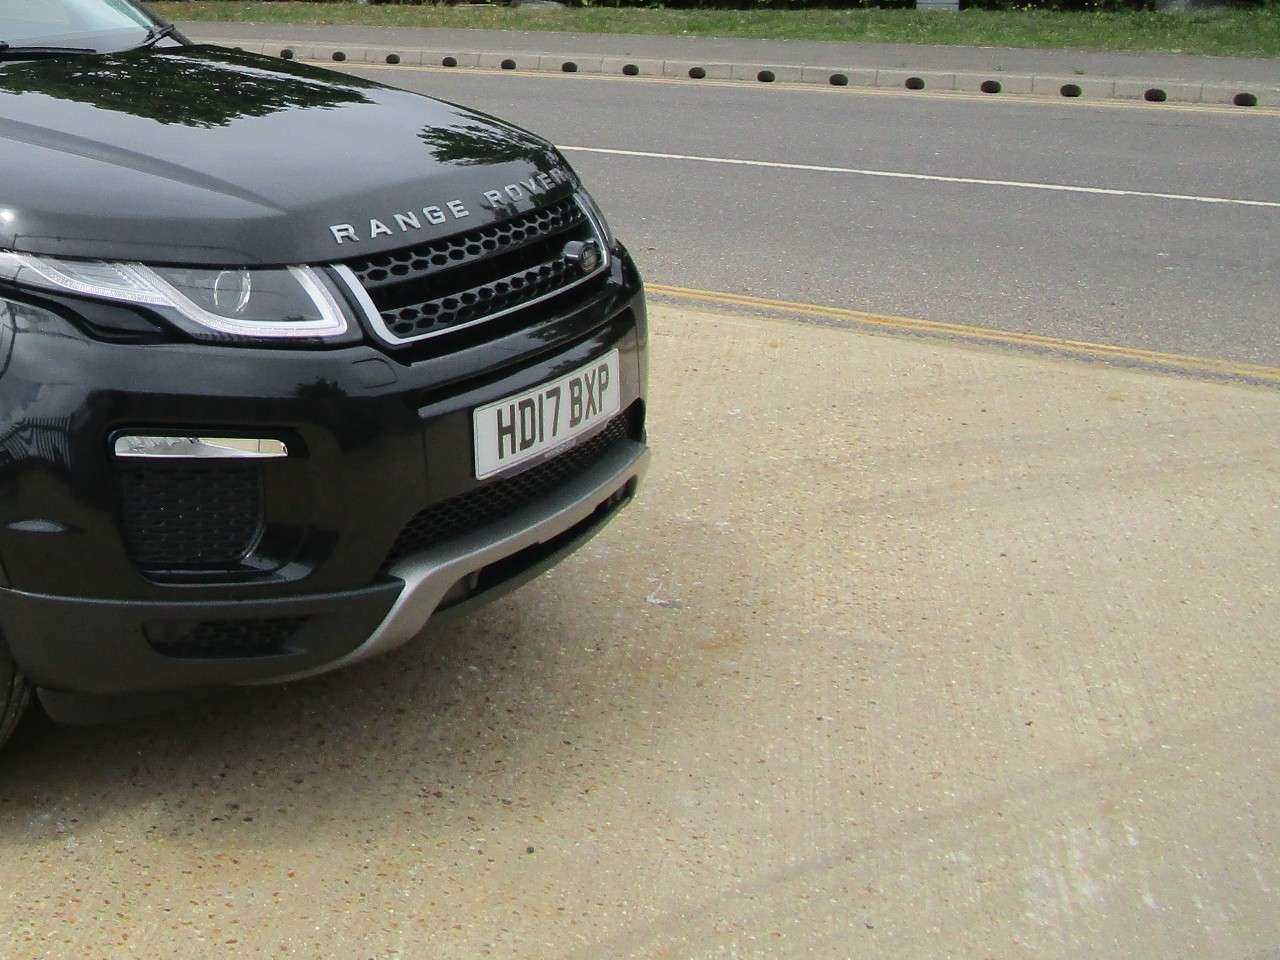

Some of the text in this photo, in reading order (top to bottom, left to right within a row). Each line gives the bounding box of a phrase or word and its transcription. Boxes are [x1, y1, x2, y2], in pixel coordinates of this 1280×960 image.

[330, 168, 567, 244] RANGE ROVER
[496, 363, 610, 460] HD17 BXP
